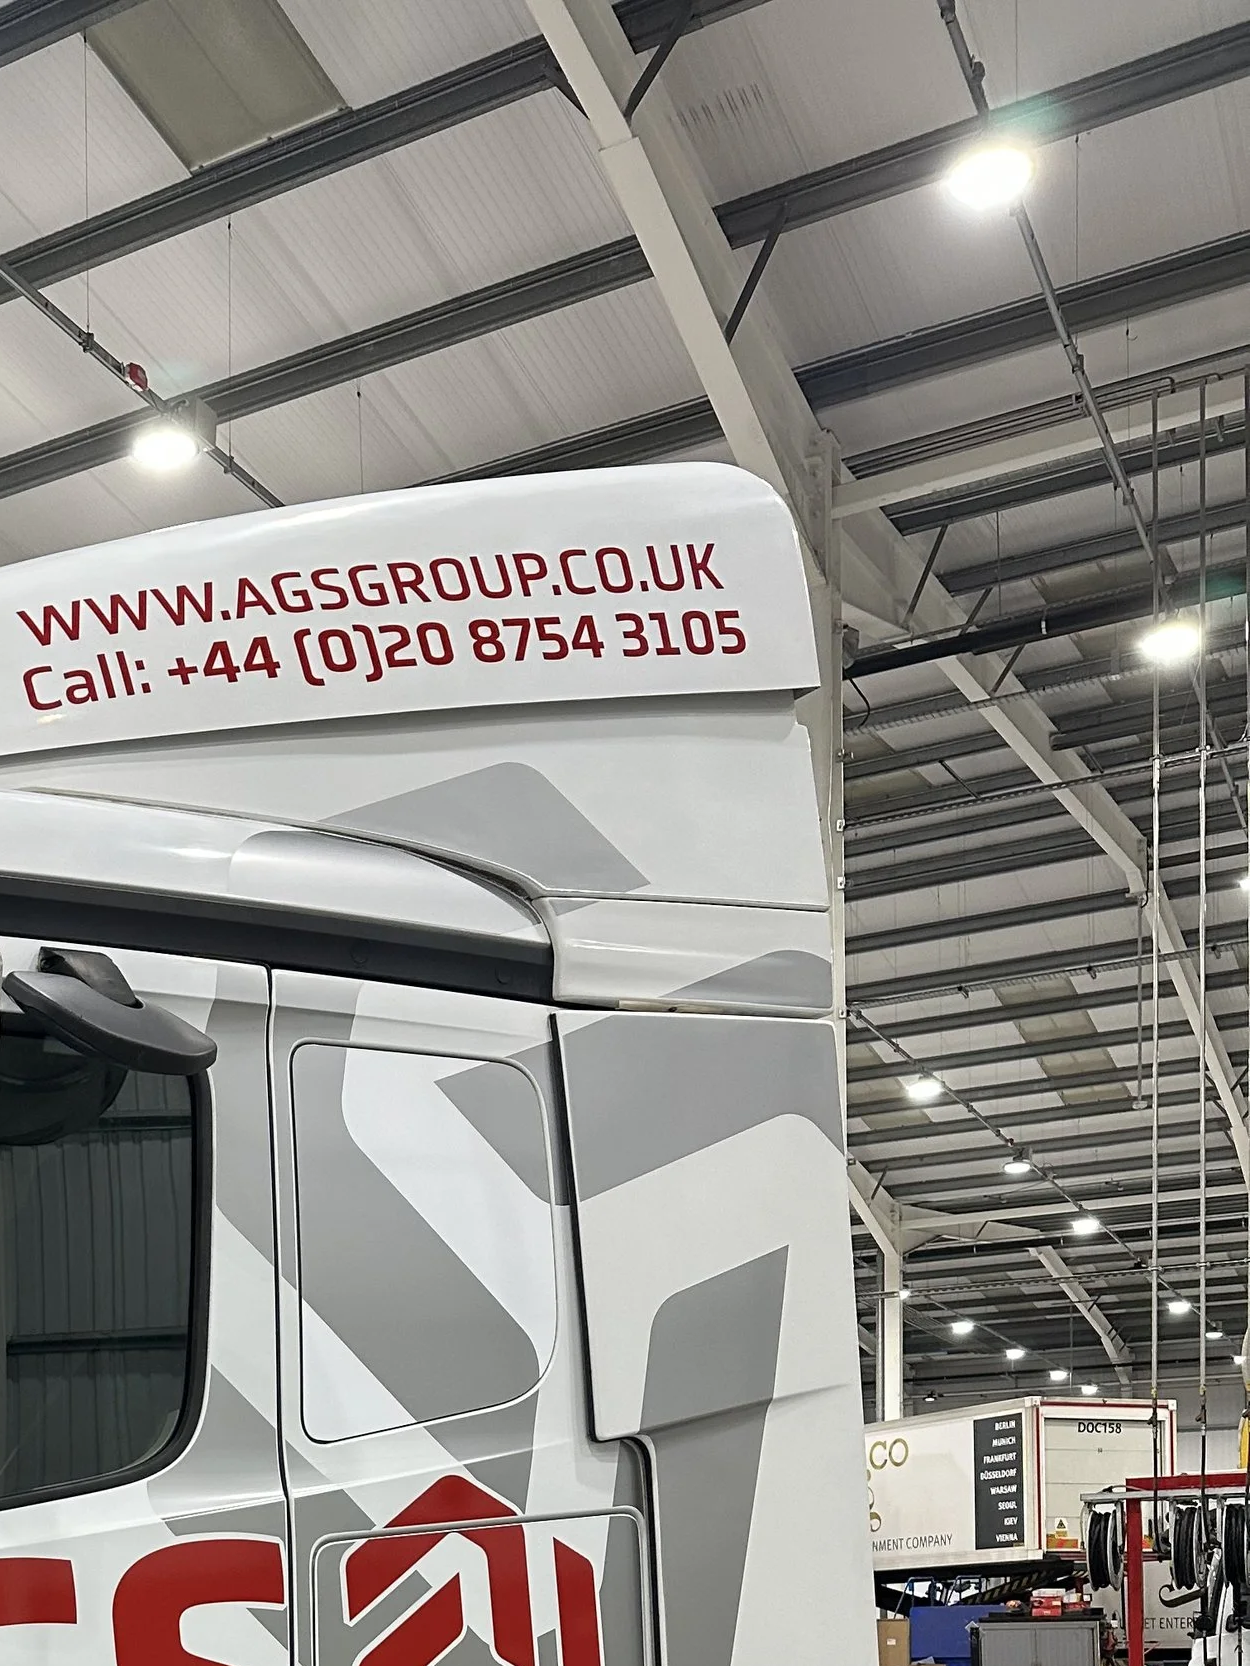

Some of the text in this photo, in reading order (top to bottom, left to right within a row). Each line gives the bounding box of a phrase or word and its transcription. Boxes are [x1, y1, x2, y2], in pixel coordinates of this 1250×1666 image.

[16, 543, 725, 647] WWW.AGSGROUP.CO.UK
[22, 649, 154, 712] Call:
[167, 636, 281, 686] +44
[472, 616, 605, 664] 8754
[621, 609, 747, 656] 3105
[994, 1420, 1016, 1431] BERLIN
[1077, 1421, 1122, 1434] DOC158
[992, 1436, 1016, 1447] MUNICH
[869, 1438, 909, 1470] CO
[983, 1452, 1017, 1464] FRANKFURT
[990, 1485, 1018, 1495] WARSAW
[998, 1501, 1018, 1510] SEOUL
[1004, 1517, 1018, 1526] KIEV
[906, 1533, 953, 1550] COMPANY
[995, 1533, 1018, 1542] VIENNA
[1159, 1616, 1195, 1630] ENTER
